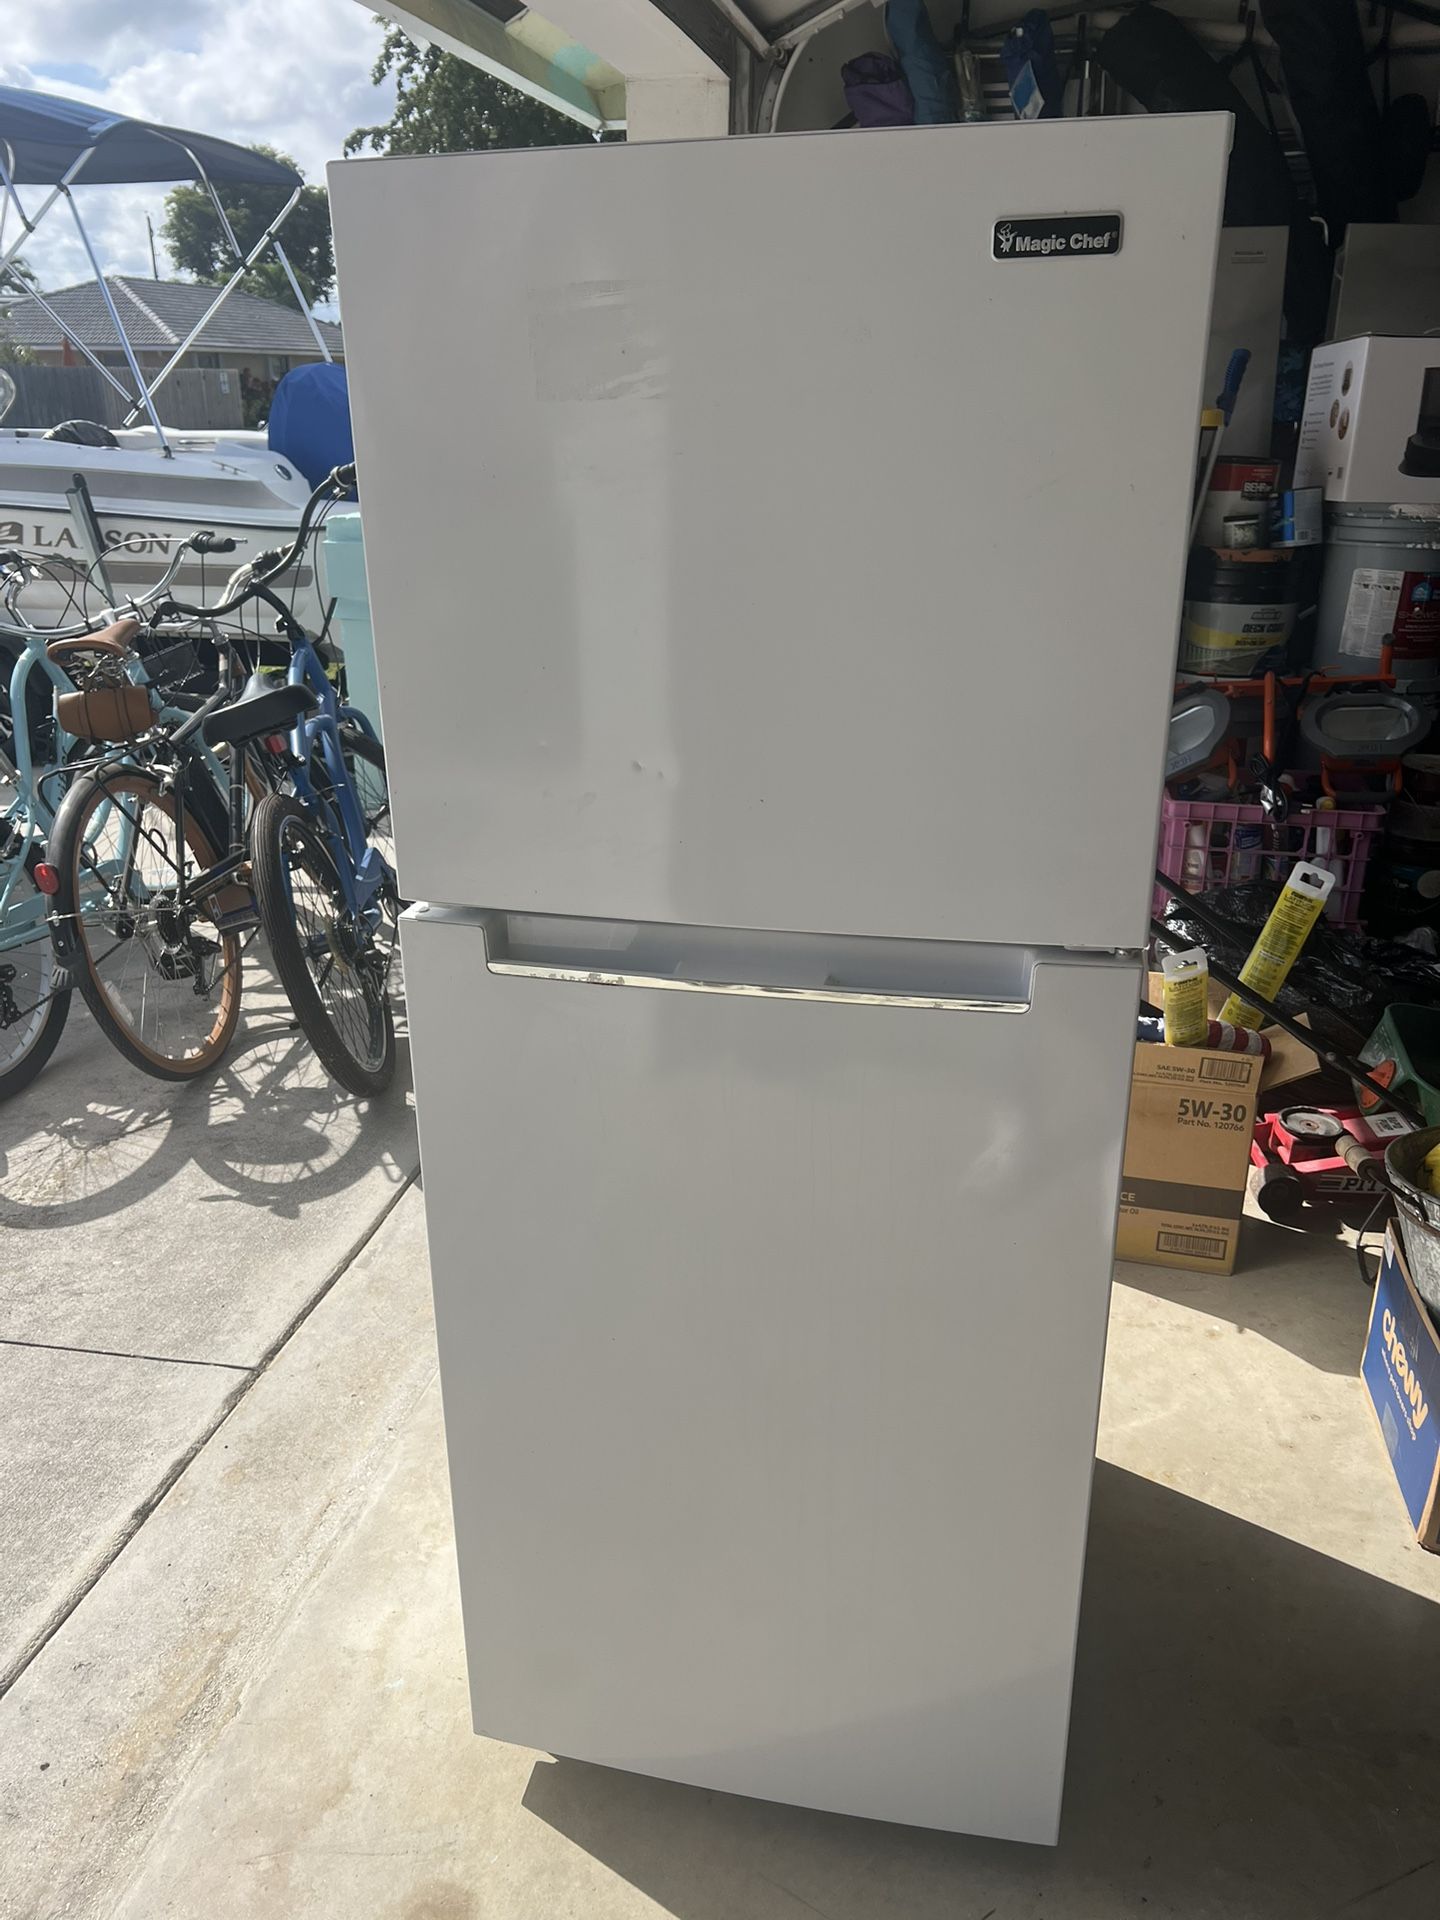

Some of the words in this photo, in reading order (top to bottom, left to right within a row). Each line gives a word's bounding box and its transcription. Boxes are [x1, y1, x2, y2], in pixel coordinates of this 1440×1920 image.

[1015, 234, 1067, 254] Magic
[1069, 232, 1112, 249] Chef
[33, 525, 172, 555] LASON
[1177, 1097, 1247, 1123] 5W-30
[1177, 1117, 1196, 1127] Part
[1197, 1118, 1212, 1128] No.
[1214, 1122, 1245, 1132] 120766
